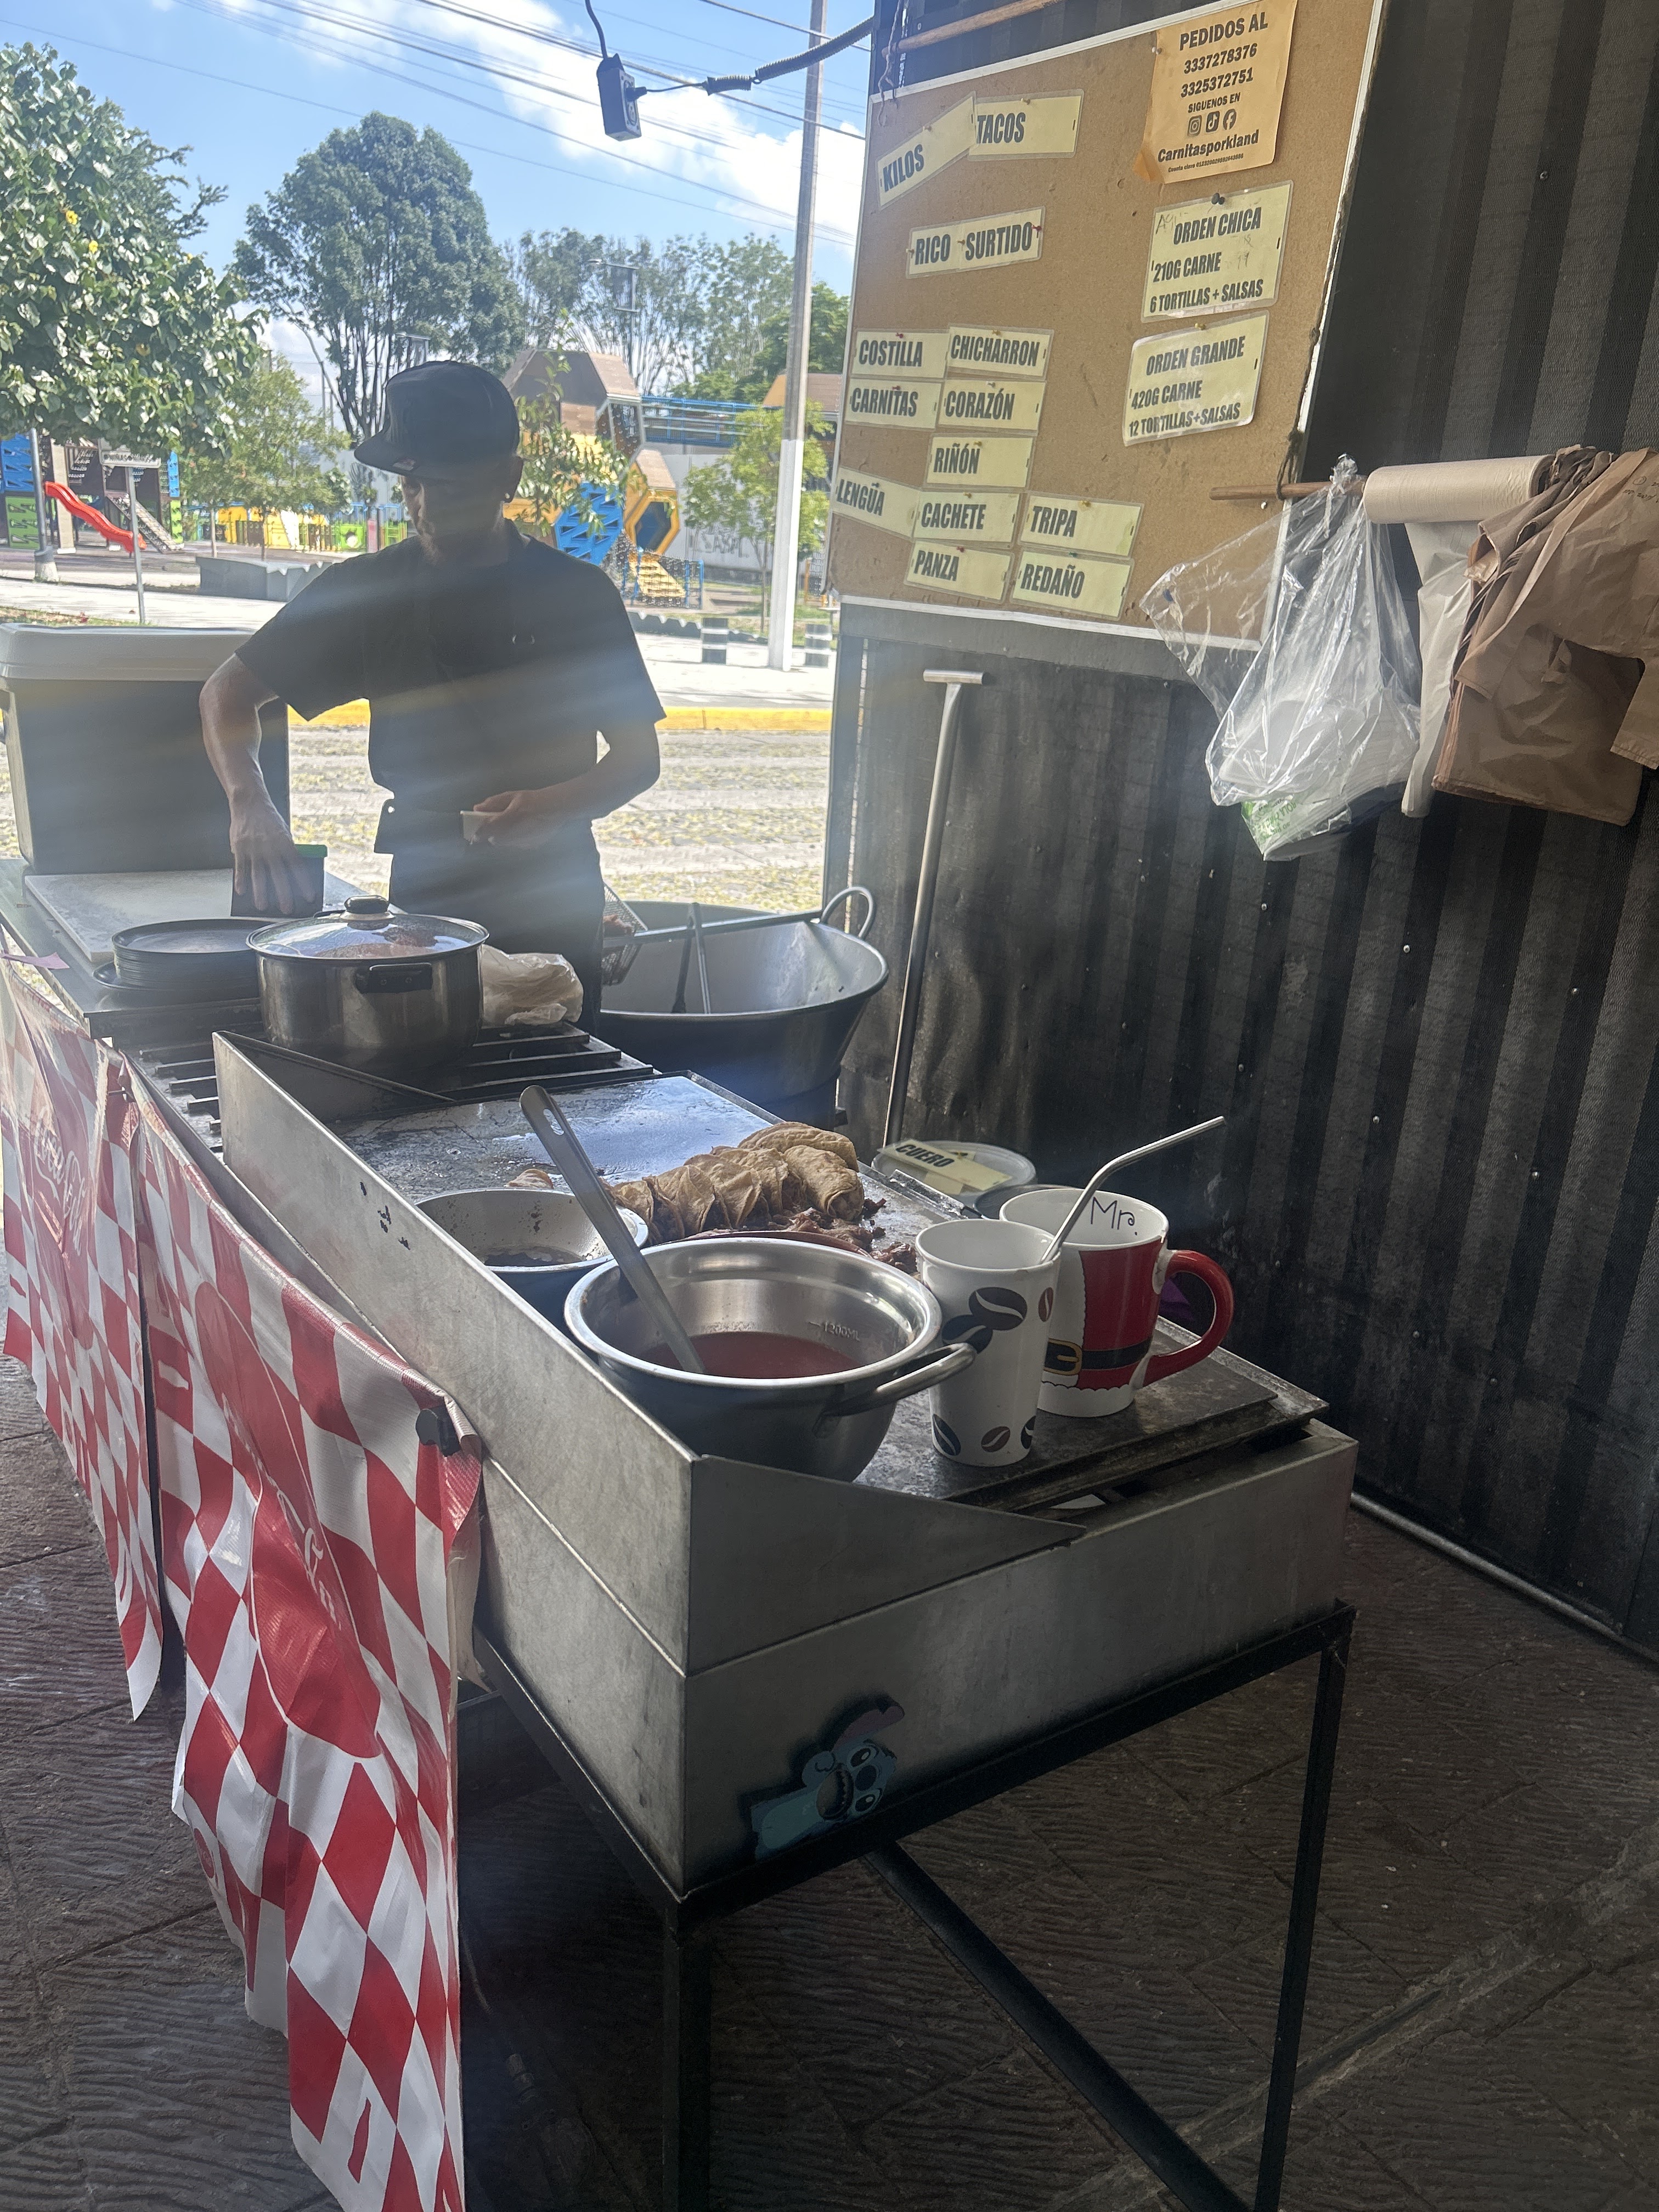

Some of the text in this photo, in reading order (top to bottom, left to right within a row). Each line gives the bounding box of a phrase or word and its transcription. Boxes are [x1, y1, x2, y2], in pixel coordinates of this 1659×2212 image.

[1180, 12, 1268, 50] PEDIDOS AL
[1184, 43, 1257, 74] 3337278376
[1181, 67, 1254, 98] 3325372751
[1188, 92, 1241, 114] SIGUENOS EN
[882, 112, 1026, 192] KILOS TACOS
[1158, 129, 1259, 162] Carnitasporkland
[1173, 216, 1217, 245] ORDEN
[1217, 207, 1262, 236] CHICA
[915, 222, 1032, 266] RICO SURTIDO
[1153, 259, 1181, 283] 210G
[1183, 252, 1222, 278] CARNE
[1149, 296, 1156, 313] 6
[1159, 287, 1211, 312] TORTILLAS
[1221, 279, 1263, 302] SALSAS
[859, 335, 1040, 367] COSTILLA CHICHARRON
[1146, 336, 1246, 376] ORDEN GRANDE
[851, 388, 1015, 420] CARNITAS CORAZÓN
[1131, 380, 1203, 410] 420G CARNE
[1129, 421, 1139, 437] 12
[933, 443, 980, 474] RIÑÓN
[837, 478, 885, 516] LENGUA
[921, 502, 1078, 538] CACHETE TRIPA
[913, 550, 1085, 599] PANZA REDAÑO
[895, 1144, 955, 1167] CUERO
[1090, 1197, 1138, 1235] Mr.
